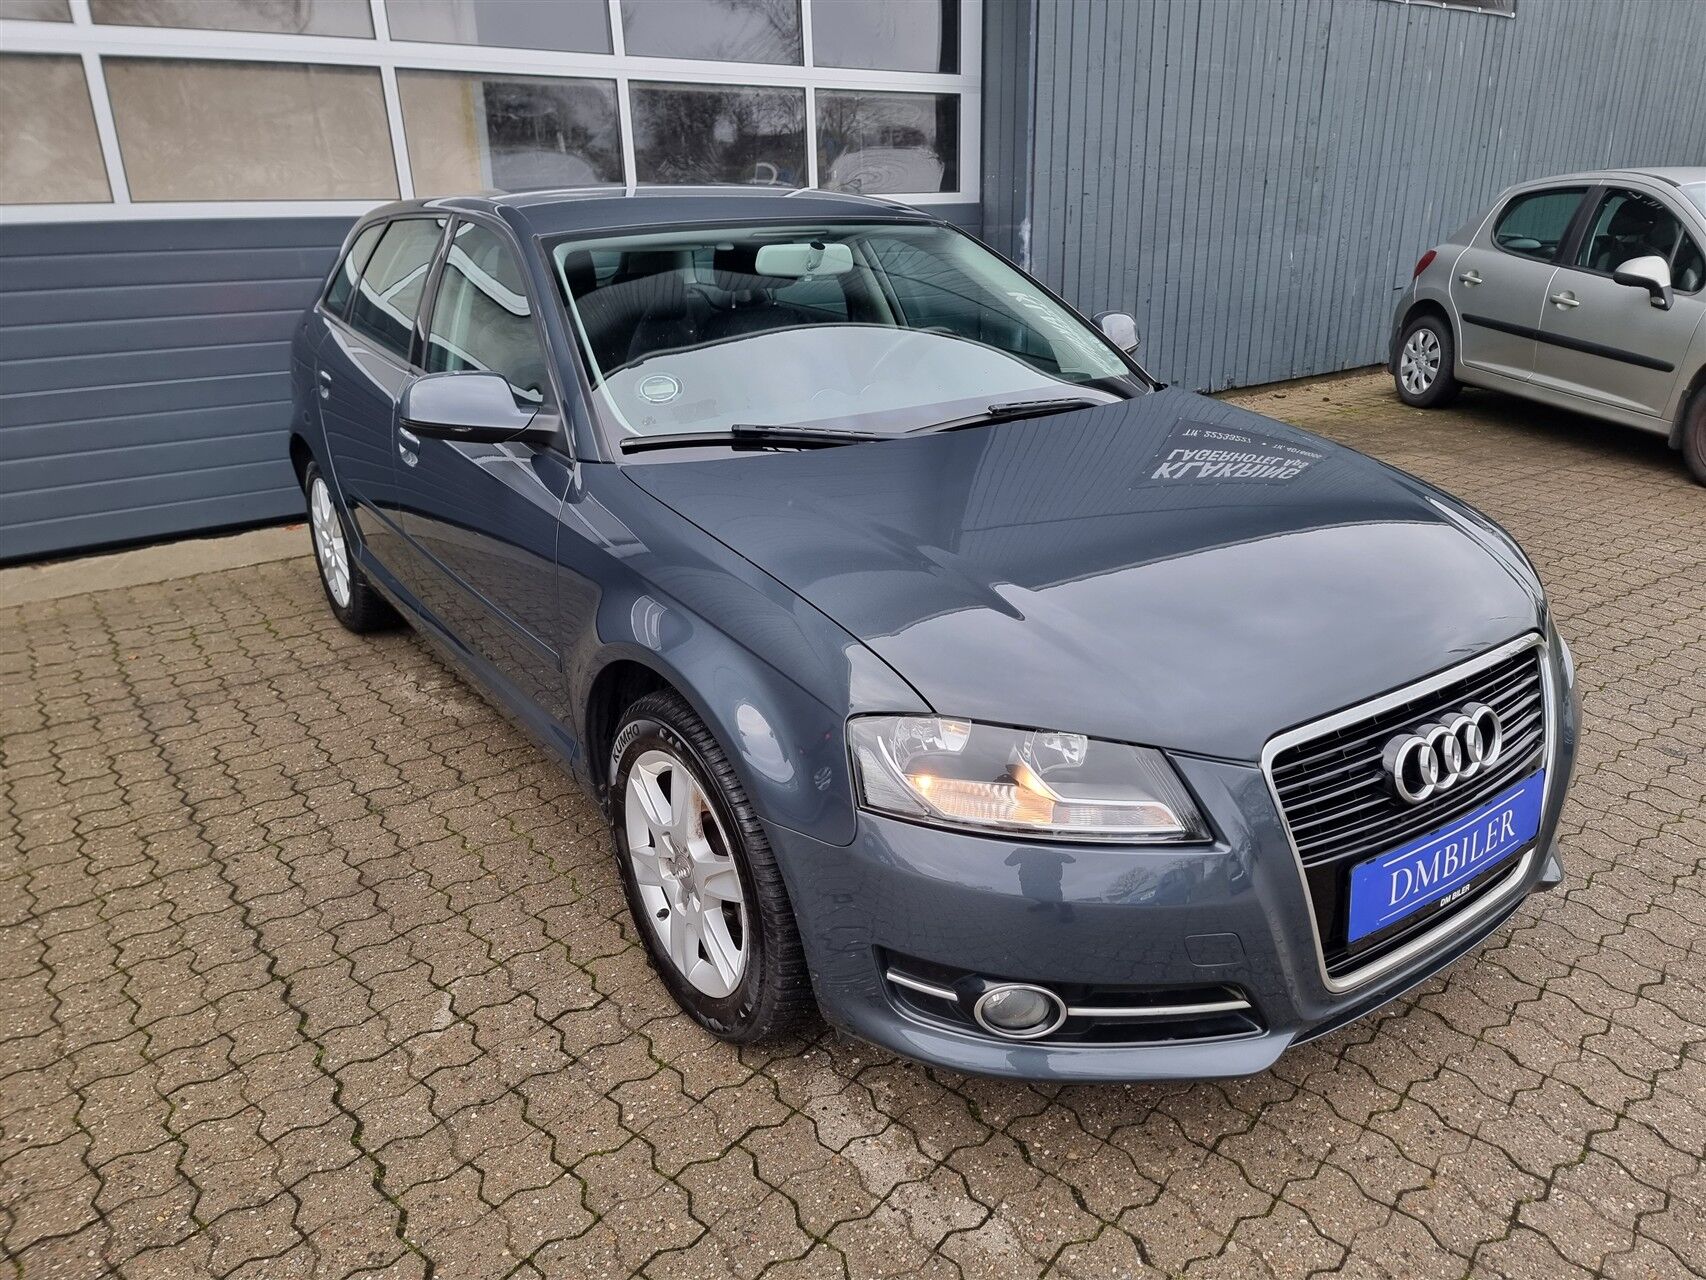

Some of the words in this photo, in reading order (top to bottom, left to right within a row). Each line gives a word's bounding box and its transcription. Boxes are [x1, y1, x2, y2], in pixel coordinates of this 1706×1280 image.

[612, 724, 640, 763] KUMHO
[1389, 809, 1515, 906] DMBILER
[1440, 894, 1451, 907] DM
[1452, 884, 1470, 900] BILER
